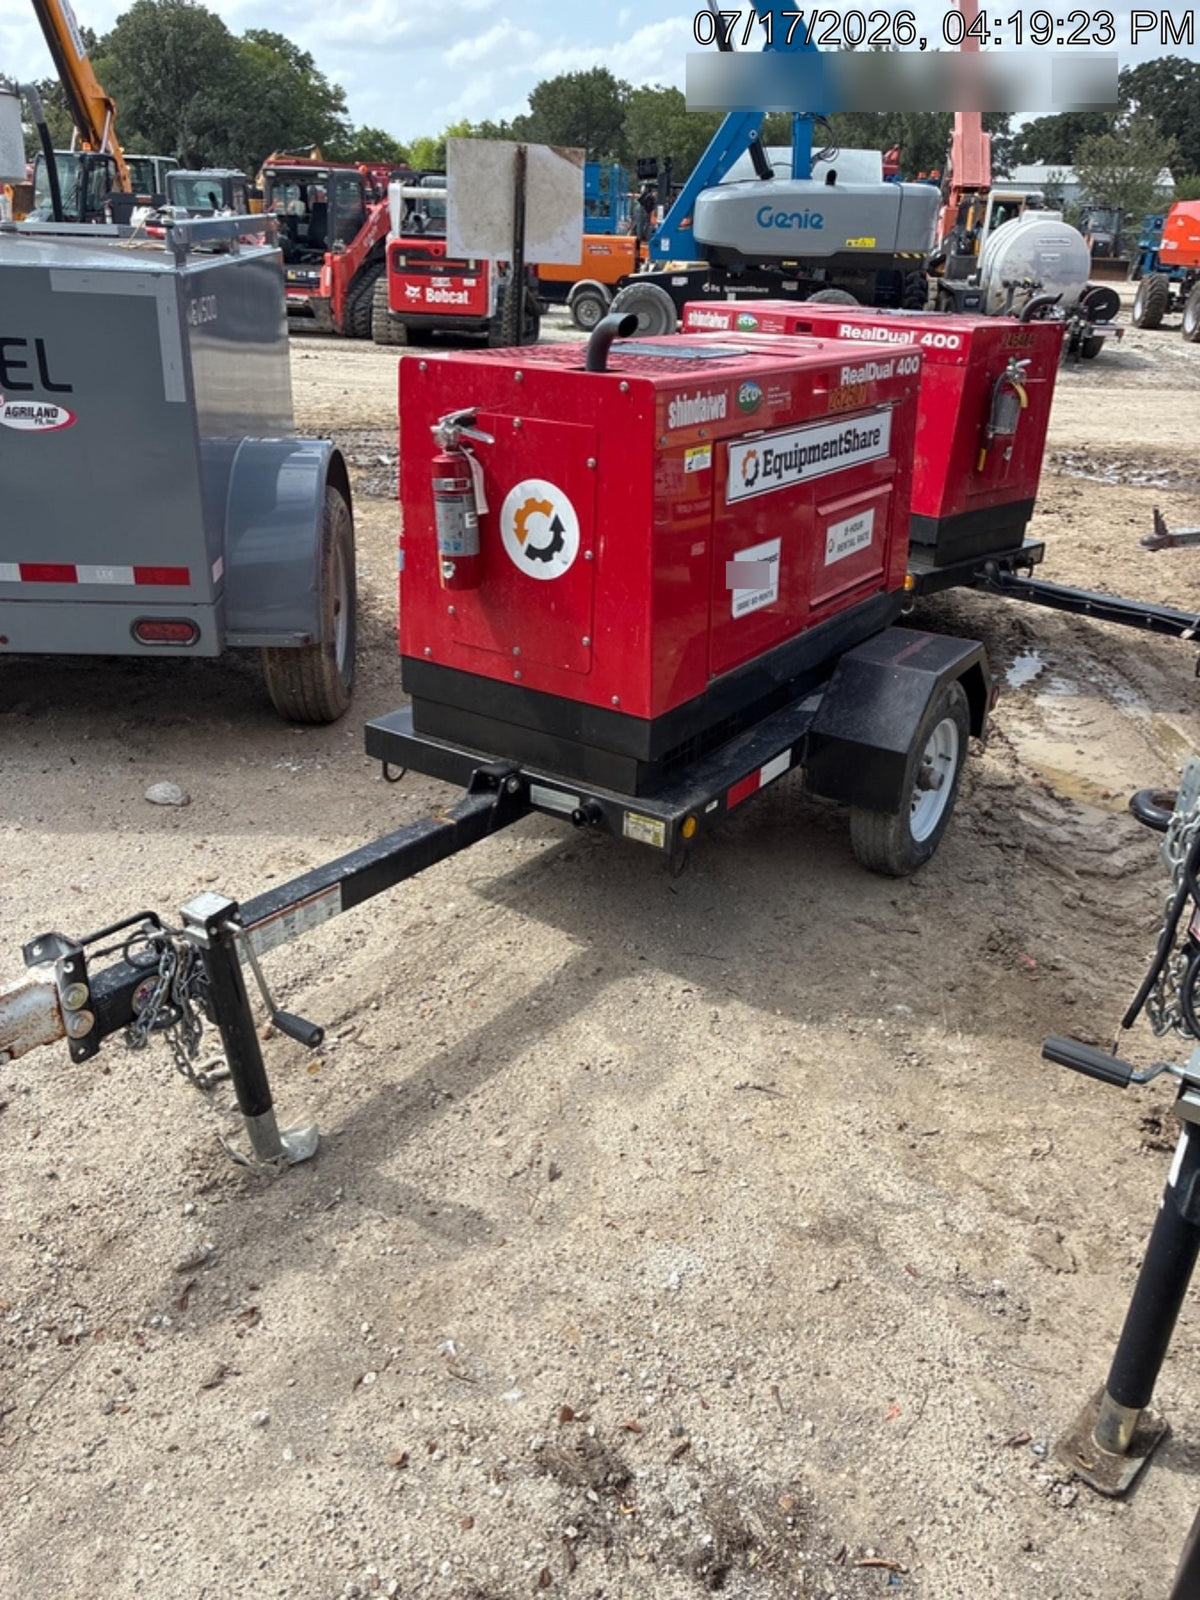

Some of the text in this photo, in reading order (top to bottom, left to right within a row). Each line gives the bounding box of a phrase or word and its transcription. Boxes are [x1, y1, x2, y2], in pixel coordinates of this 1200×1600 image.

[757, 206, 824, 229] Genie
[425, 288, 469, 304] Bobcat
[839, 323, 960, 349] RealDual 400
[0, 337, 73, 393] EL
[840, 357, 920, 386] RealDual 400
[4, 406, 59, 419] AGRILAND
[668, 390, 727, 429] shindaiwa
[762, 427, 881, 480] EquipmentShare
